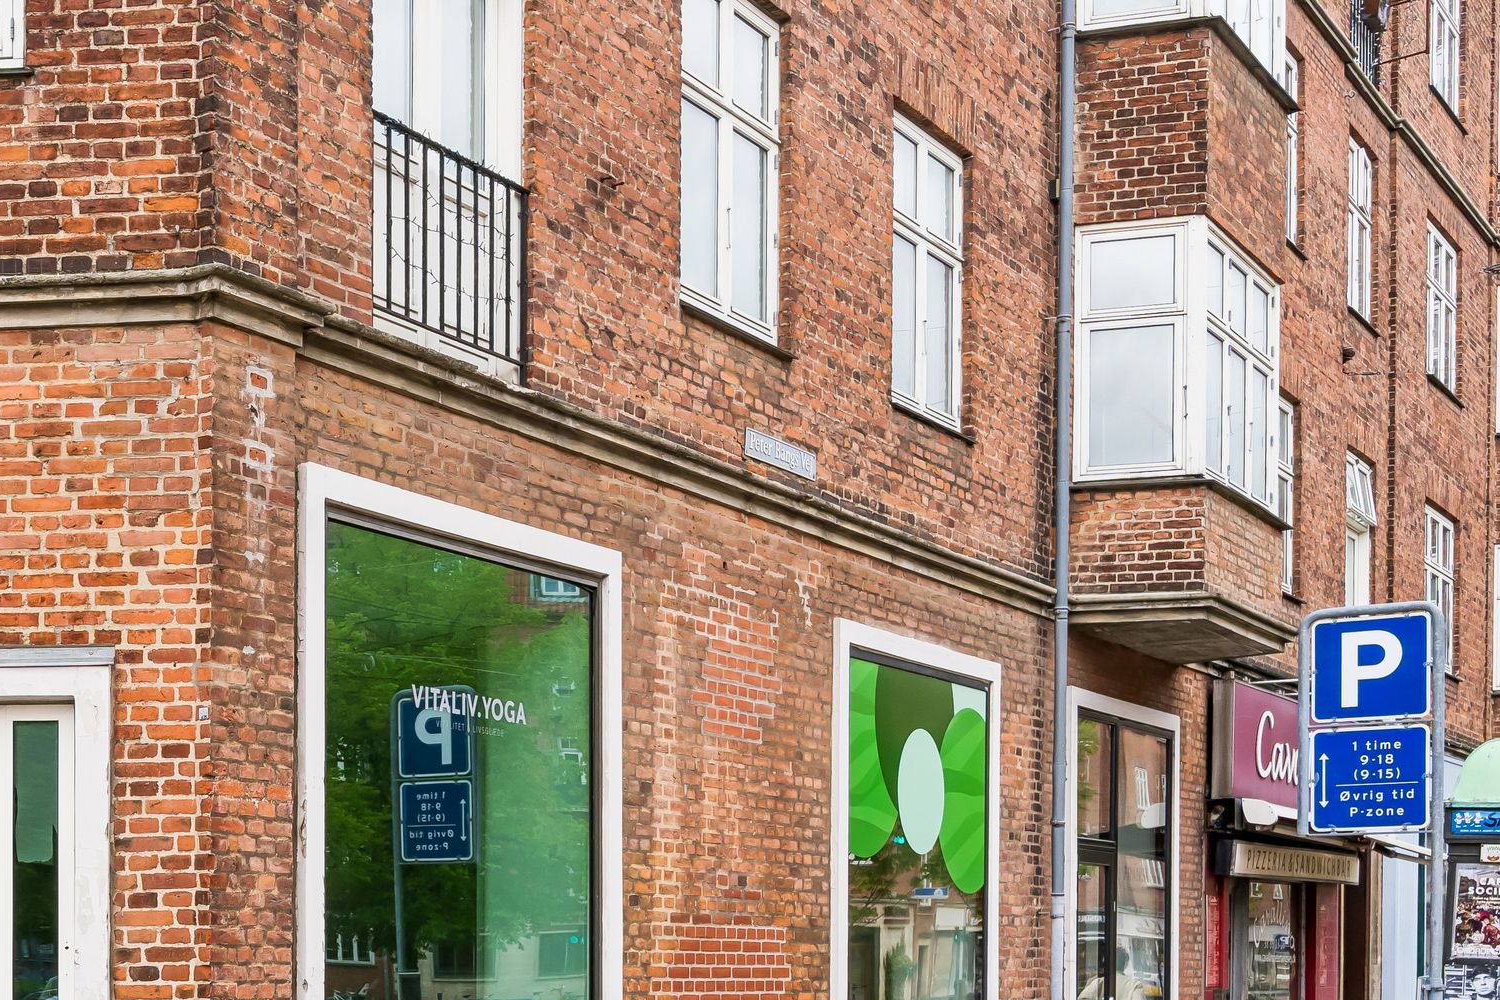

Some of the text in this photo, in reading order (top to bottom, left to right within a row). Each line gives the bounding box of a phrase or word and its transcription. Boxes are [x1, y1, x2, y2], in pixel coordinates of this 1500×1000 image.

[749, 431, 813, 477] Peter Bangs Vej
[1341, 629, 1403, 708] P
[411, 684, 527, 726] VITALIV.YOGA
[1352, 739, 1402, 751] 1 time
[1359, 753, 1394, 765] 9-18
[1353, 767, 1401, 781] (9-15)
[1339, 788, 1415, 802] Øvrig tid
[1349, 805, 1405, 817] P-zone
[1467, 886, 1500, 895] SOCI
